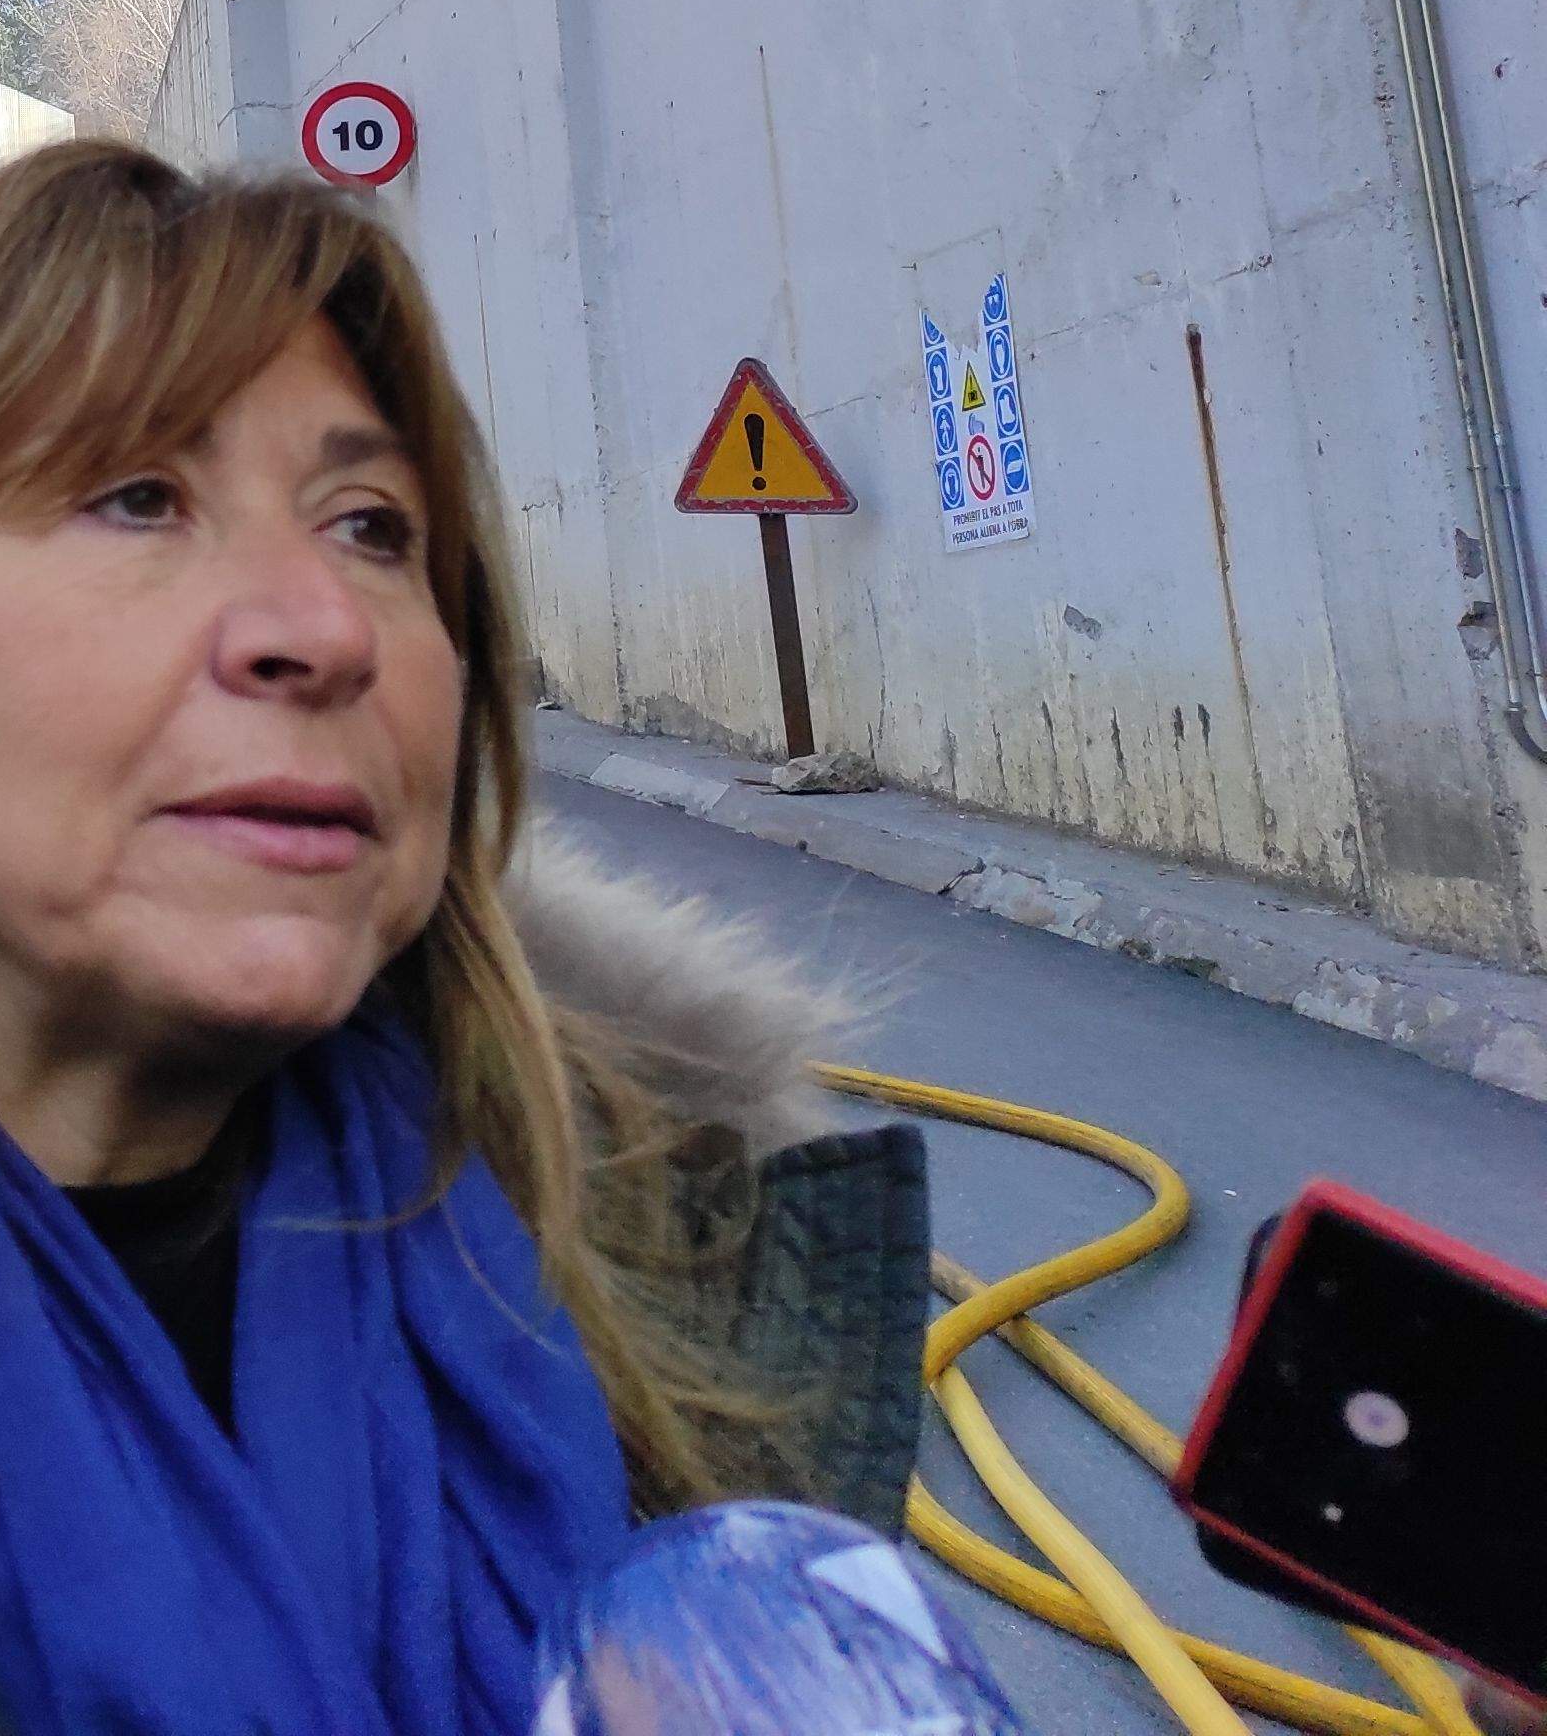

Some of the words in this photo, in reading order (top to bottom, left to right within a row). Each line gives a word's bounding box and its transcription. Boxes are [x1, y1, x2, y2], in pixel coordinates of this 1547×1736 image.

[332, 120, 383, 151] 10
[953, 510, 981, 526] PROHIBIT
[982, 508, 989, 520] EL
[990, 505, 1001, 517] PAS
[1008, 500, 1023, 513] TOTA
[952, 528, 979, 544] PERSONA
[980, 524, 1002, 539] ALIENA
